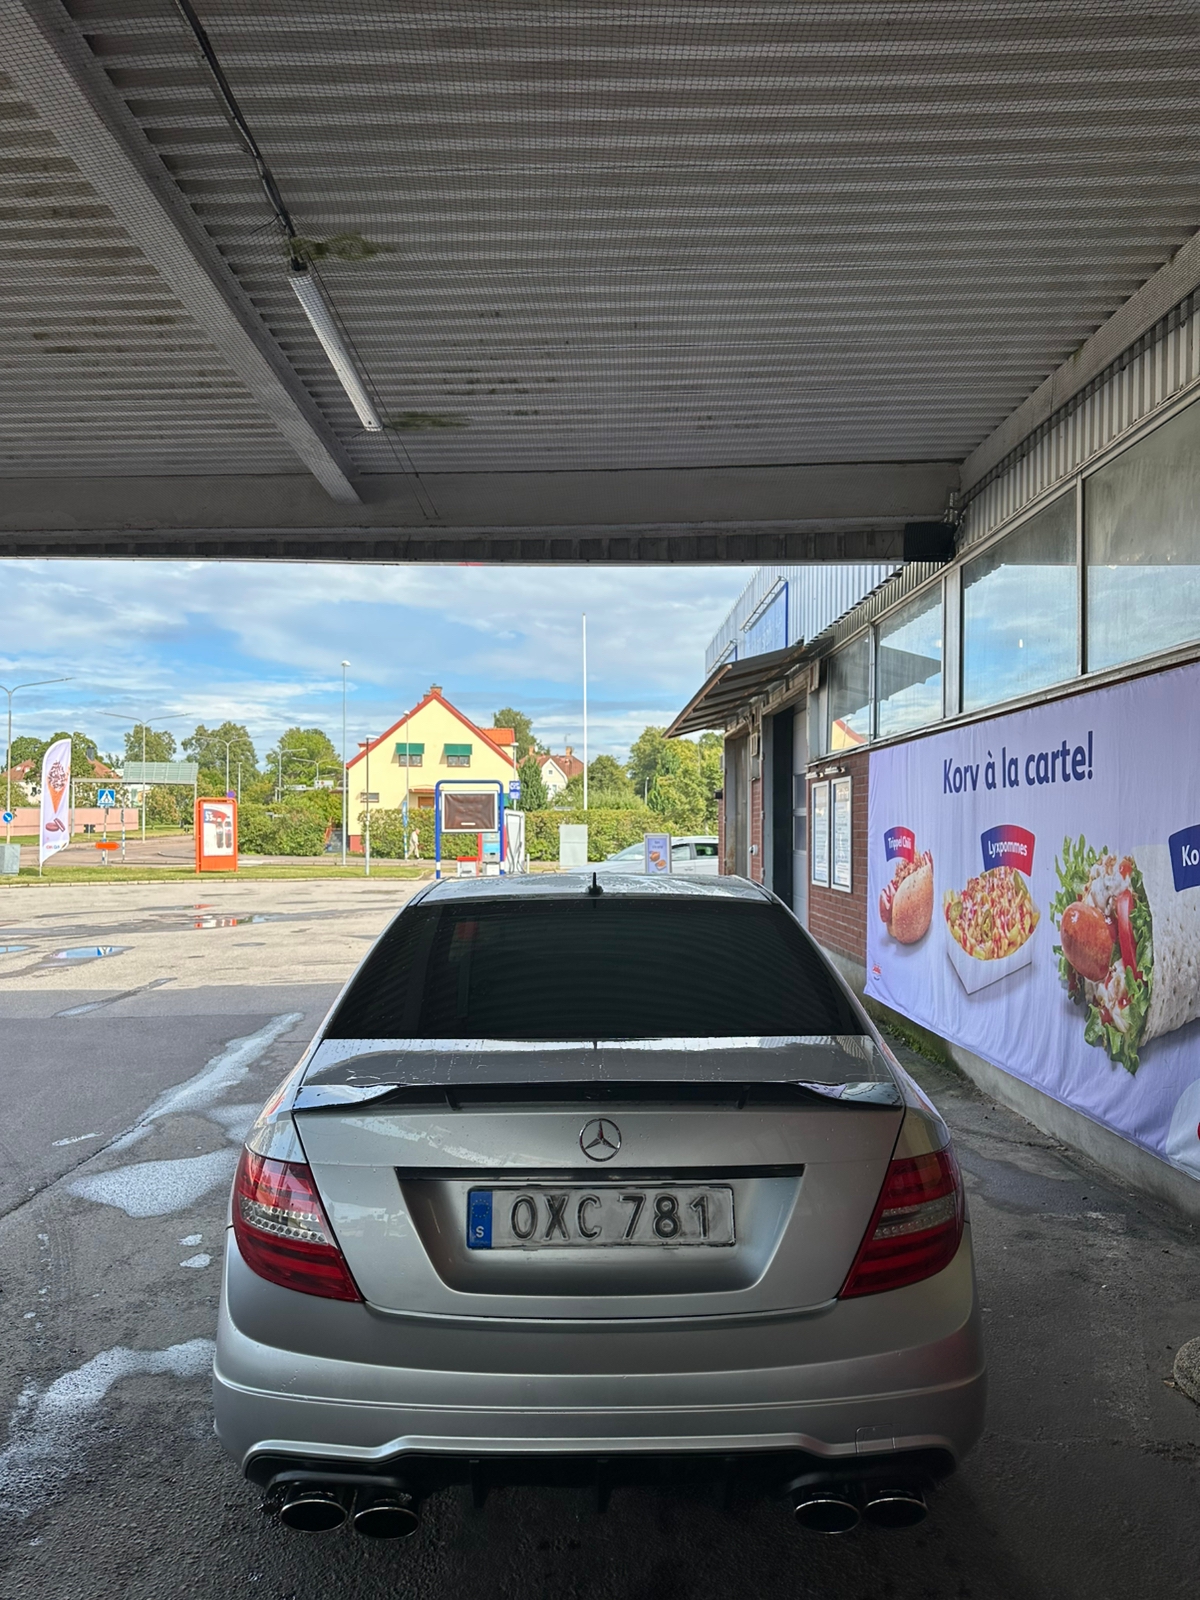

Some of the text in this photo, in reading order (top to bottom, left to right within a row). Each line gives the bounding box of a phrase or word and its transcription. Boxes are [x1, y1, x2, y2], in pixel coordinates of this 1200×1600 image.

[943, 730, 1094, 793] Korv à la carte!
[888, 836, 903, 851] Trippel
[988, 840, 1028, 858] Lyxpommes
[1181, 844, 1200, 867] Ko
[475, 1193, 710, 1240] S OXC 781
